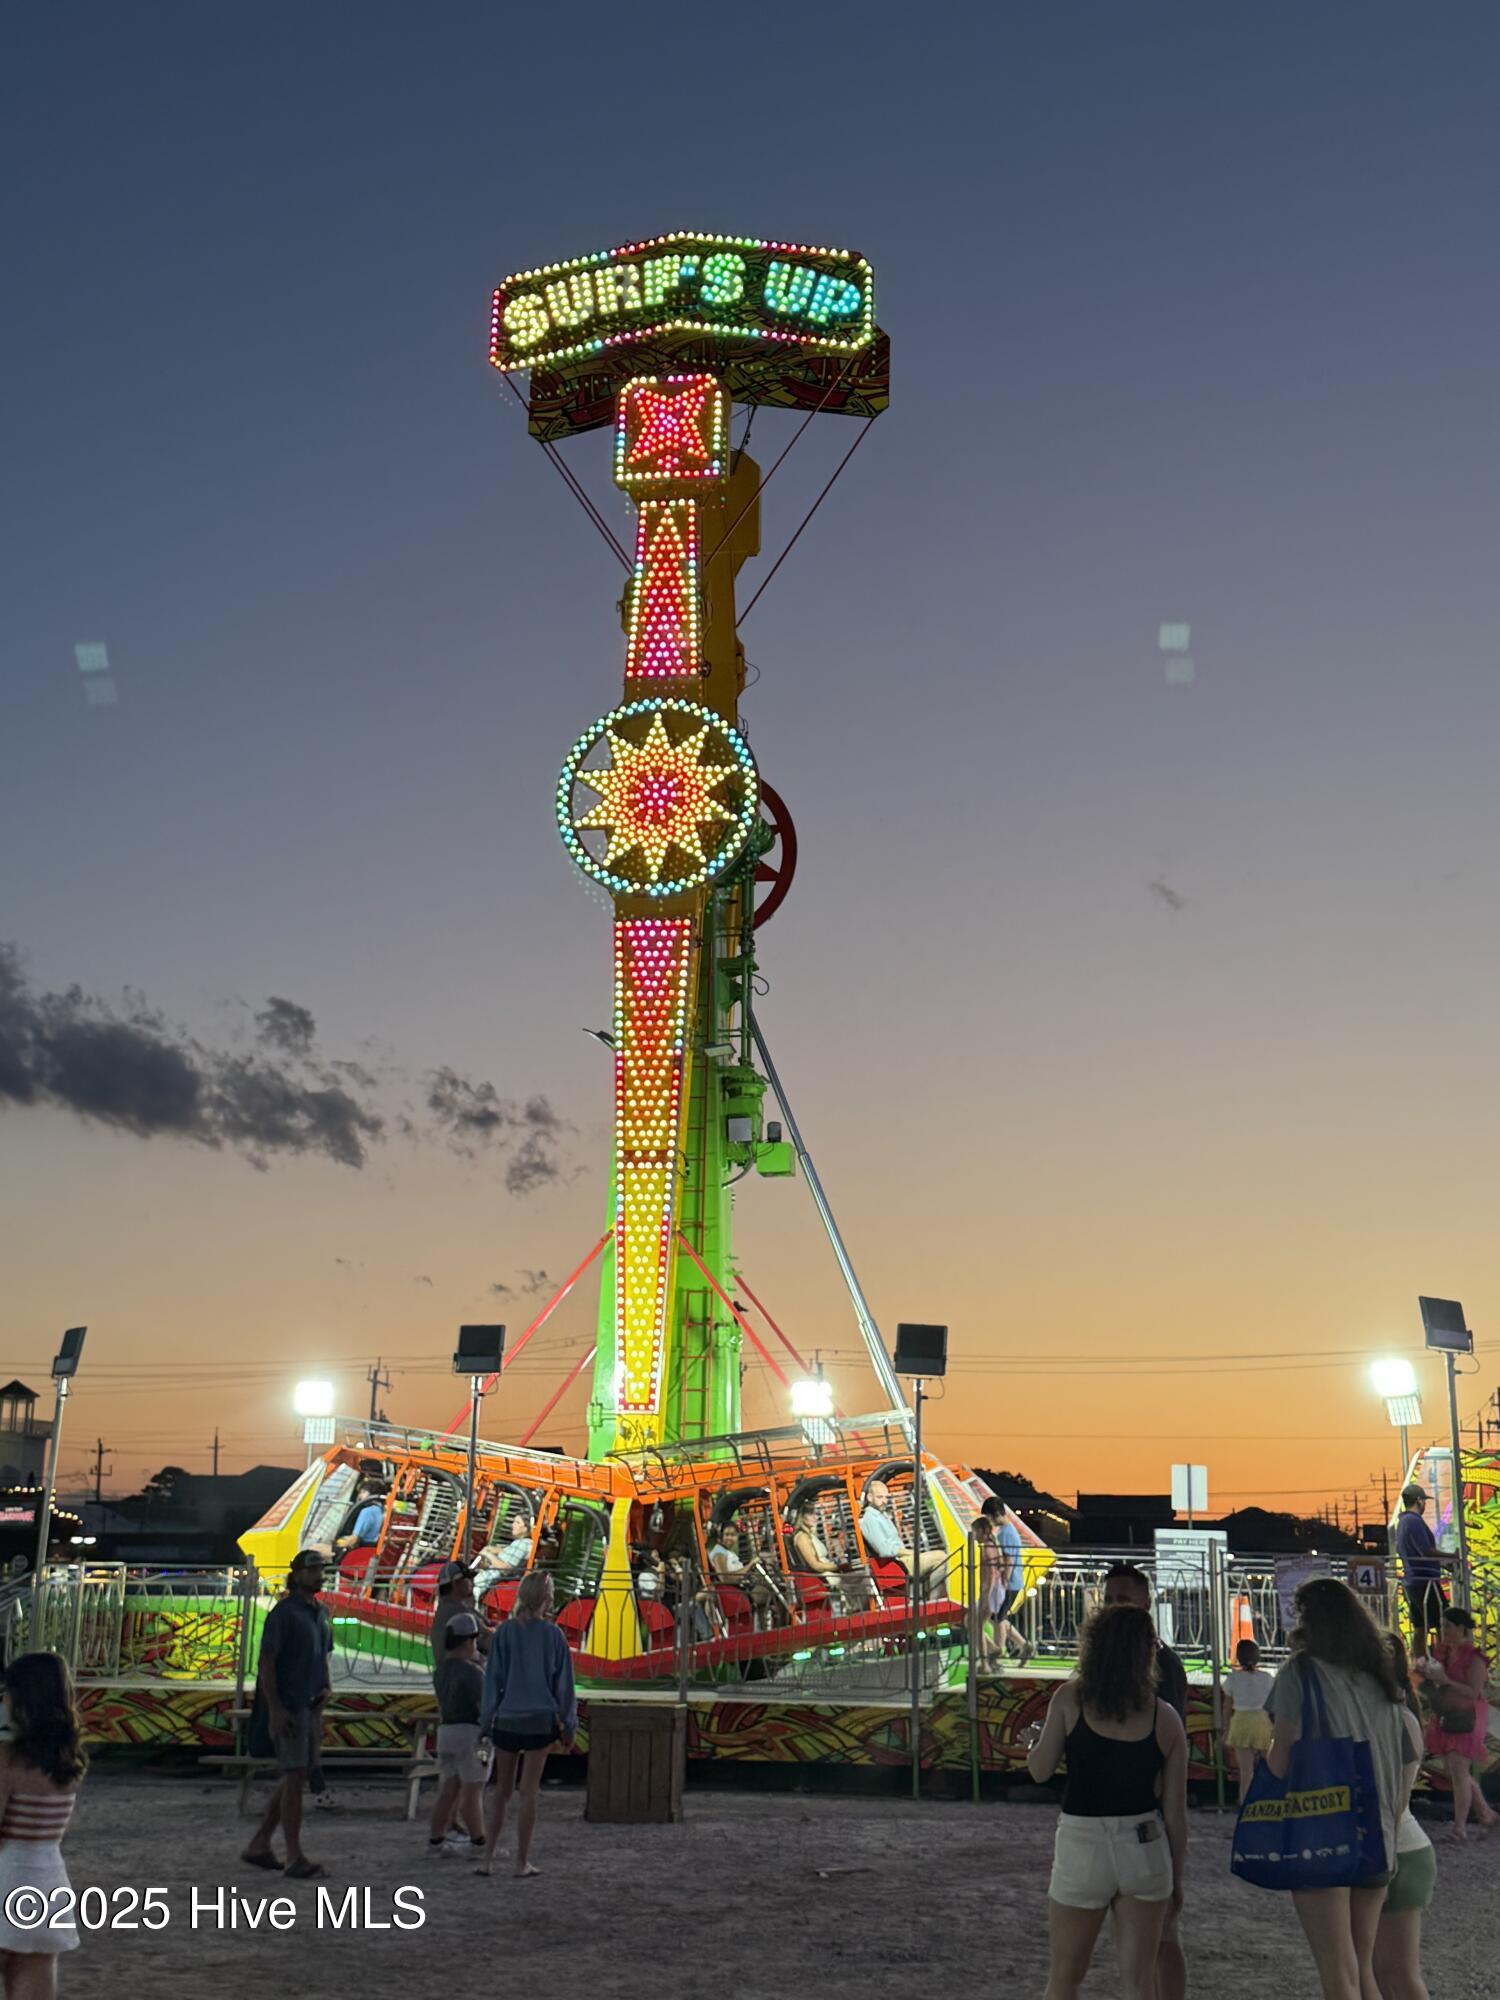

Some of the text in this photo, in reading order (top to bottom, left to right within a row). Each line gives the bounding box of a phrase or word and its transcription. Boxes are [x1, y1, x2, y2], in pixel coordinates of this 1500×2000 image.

[503, 252, 862, 347] SURF'S UP
[1360, 1569, 1373, 1586] 4
